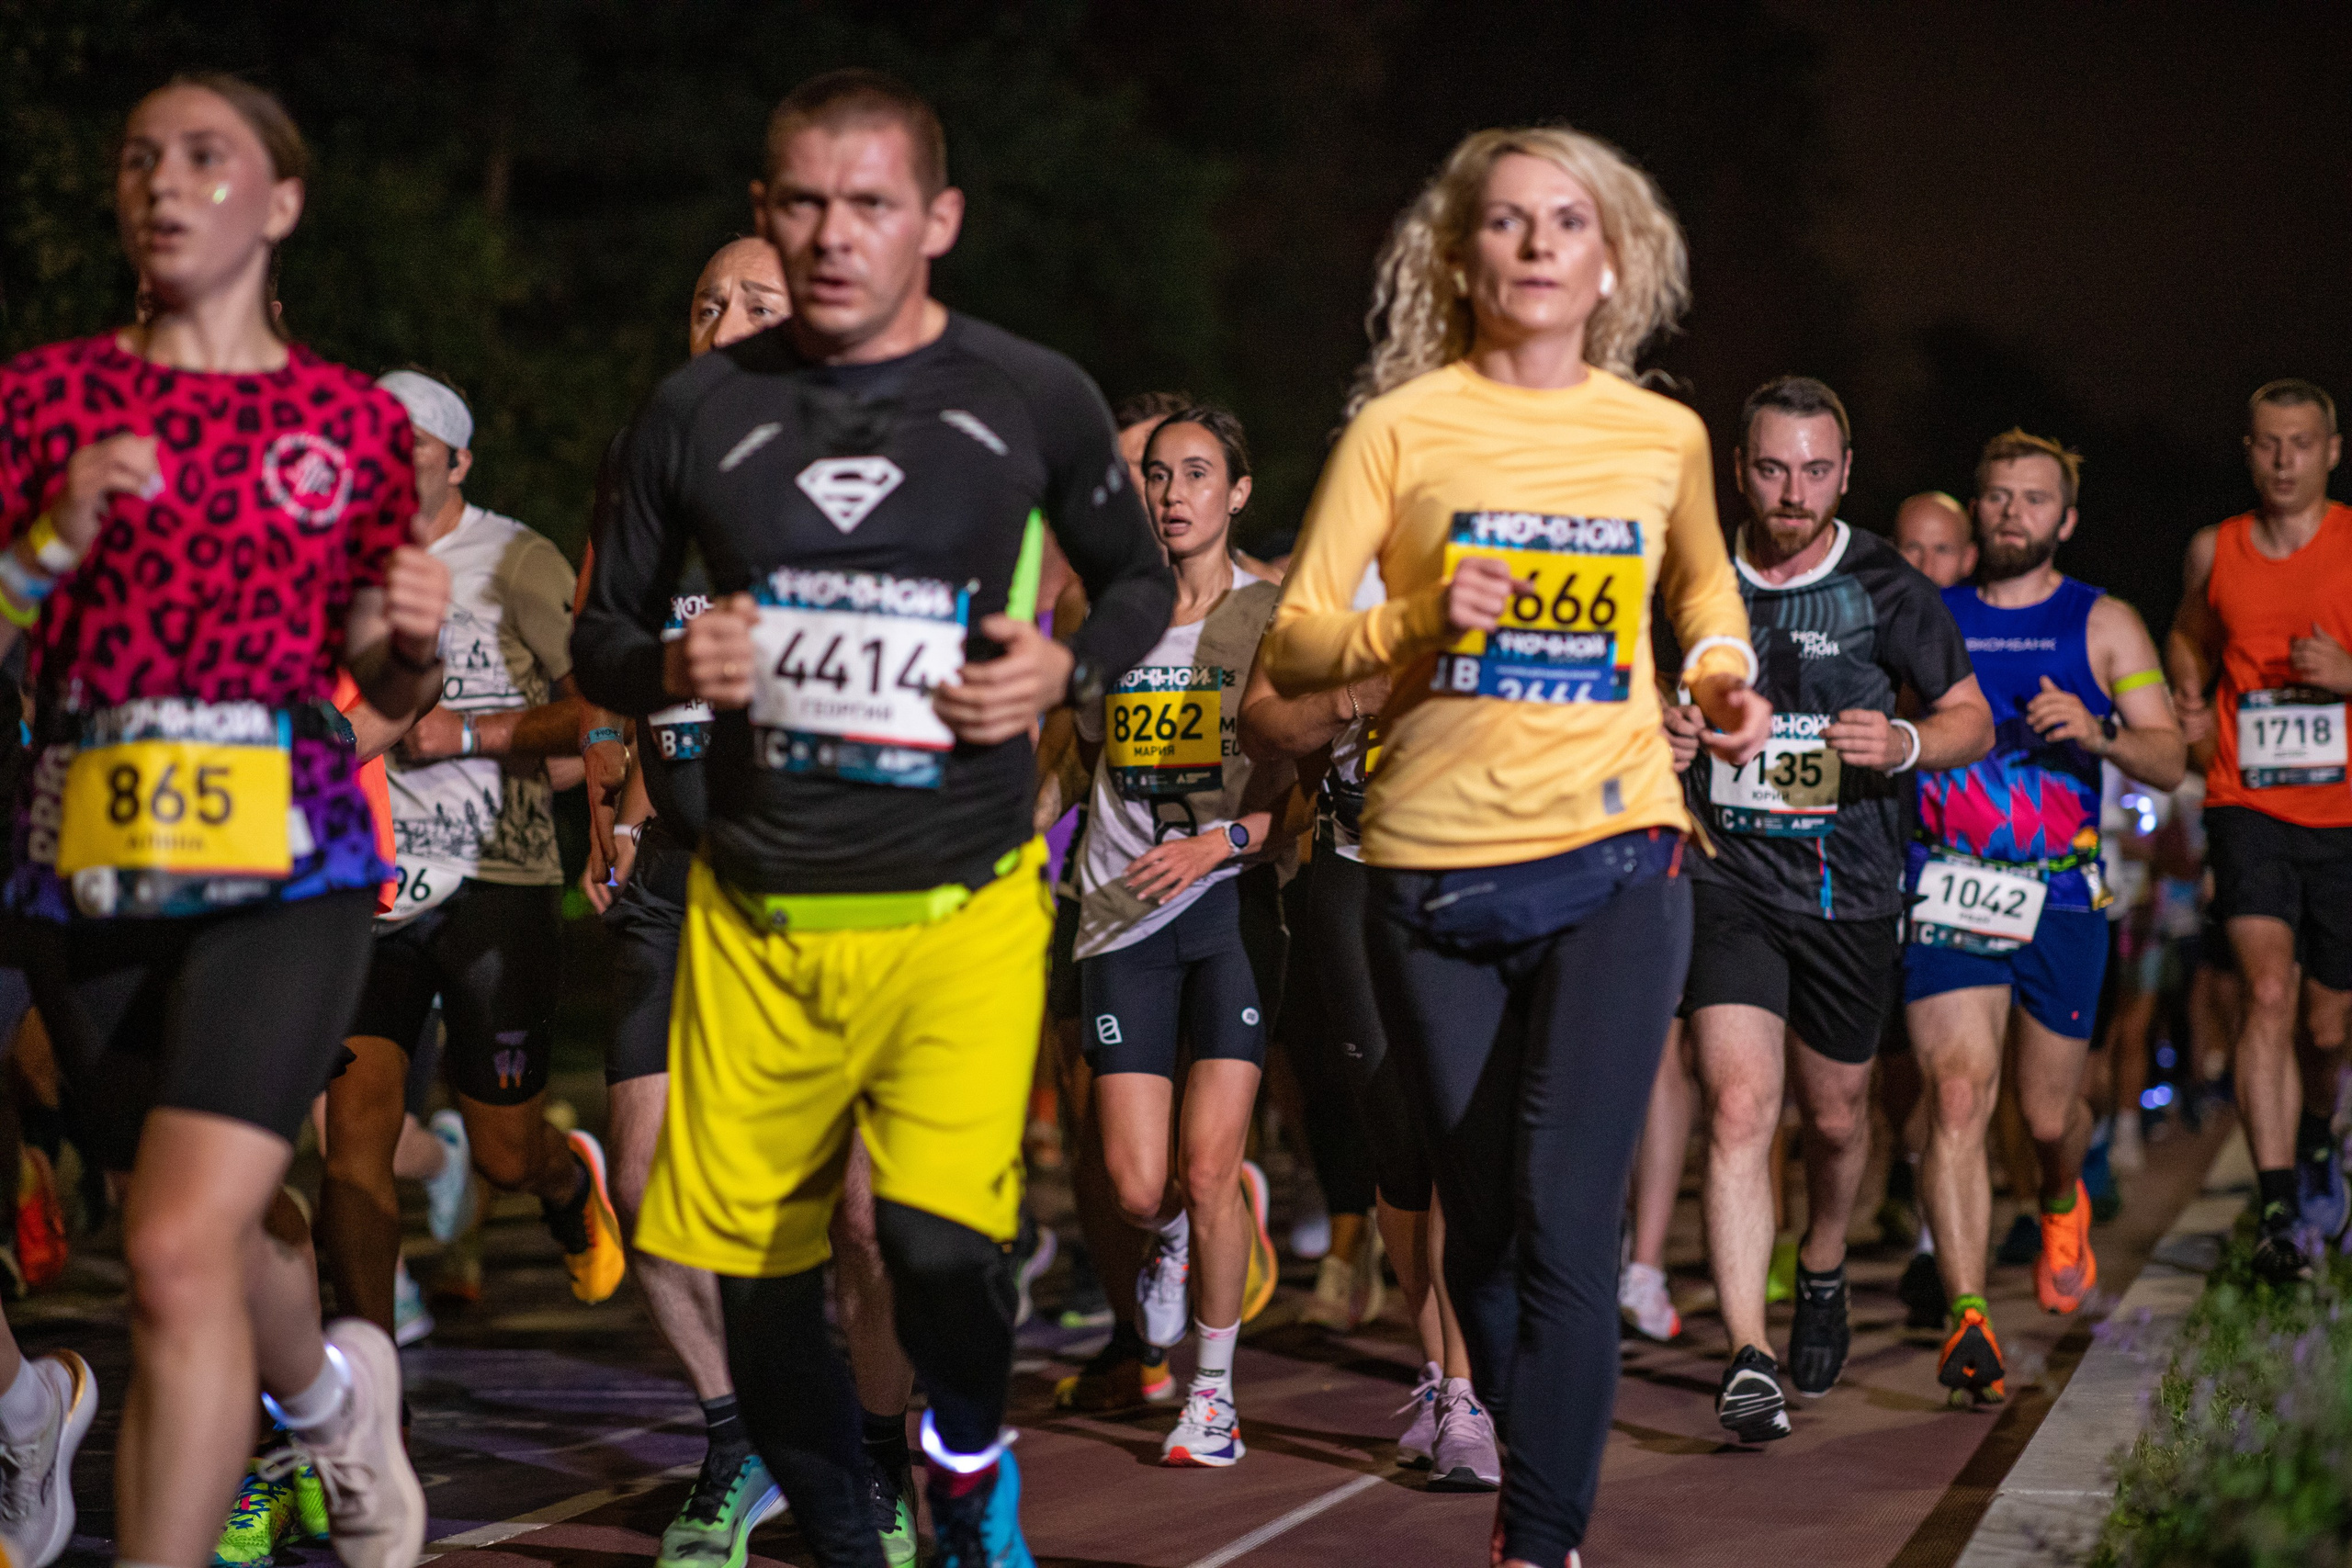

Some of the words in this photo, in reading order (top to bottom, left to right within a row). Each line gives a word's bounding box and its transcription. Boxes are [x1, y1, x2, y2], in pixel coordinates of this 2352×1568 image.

[1513, 570, 1617, 627] 666
[775, 630, 927, 700] 4414
[1114, 704, 1204, 742] 8262
[2254, 716, 2331, 747] 1718
[1134, 745, 1175, 757] МАРИЯ
[108, 764, 233, 827] 865
[1941, 874, 2028, 919] 1042
